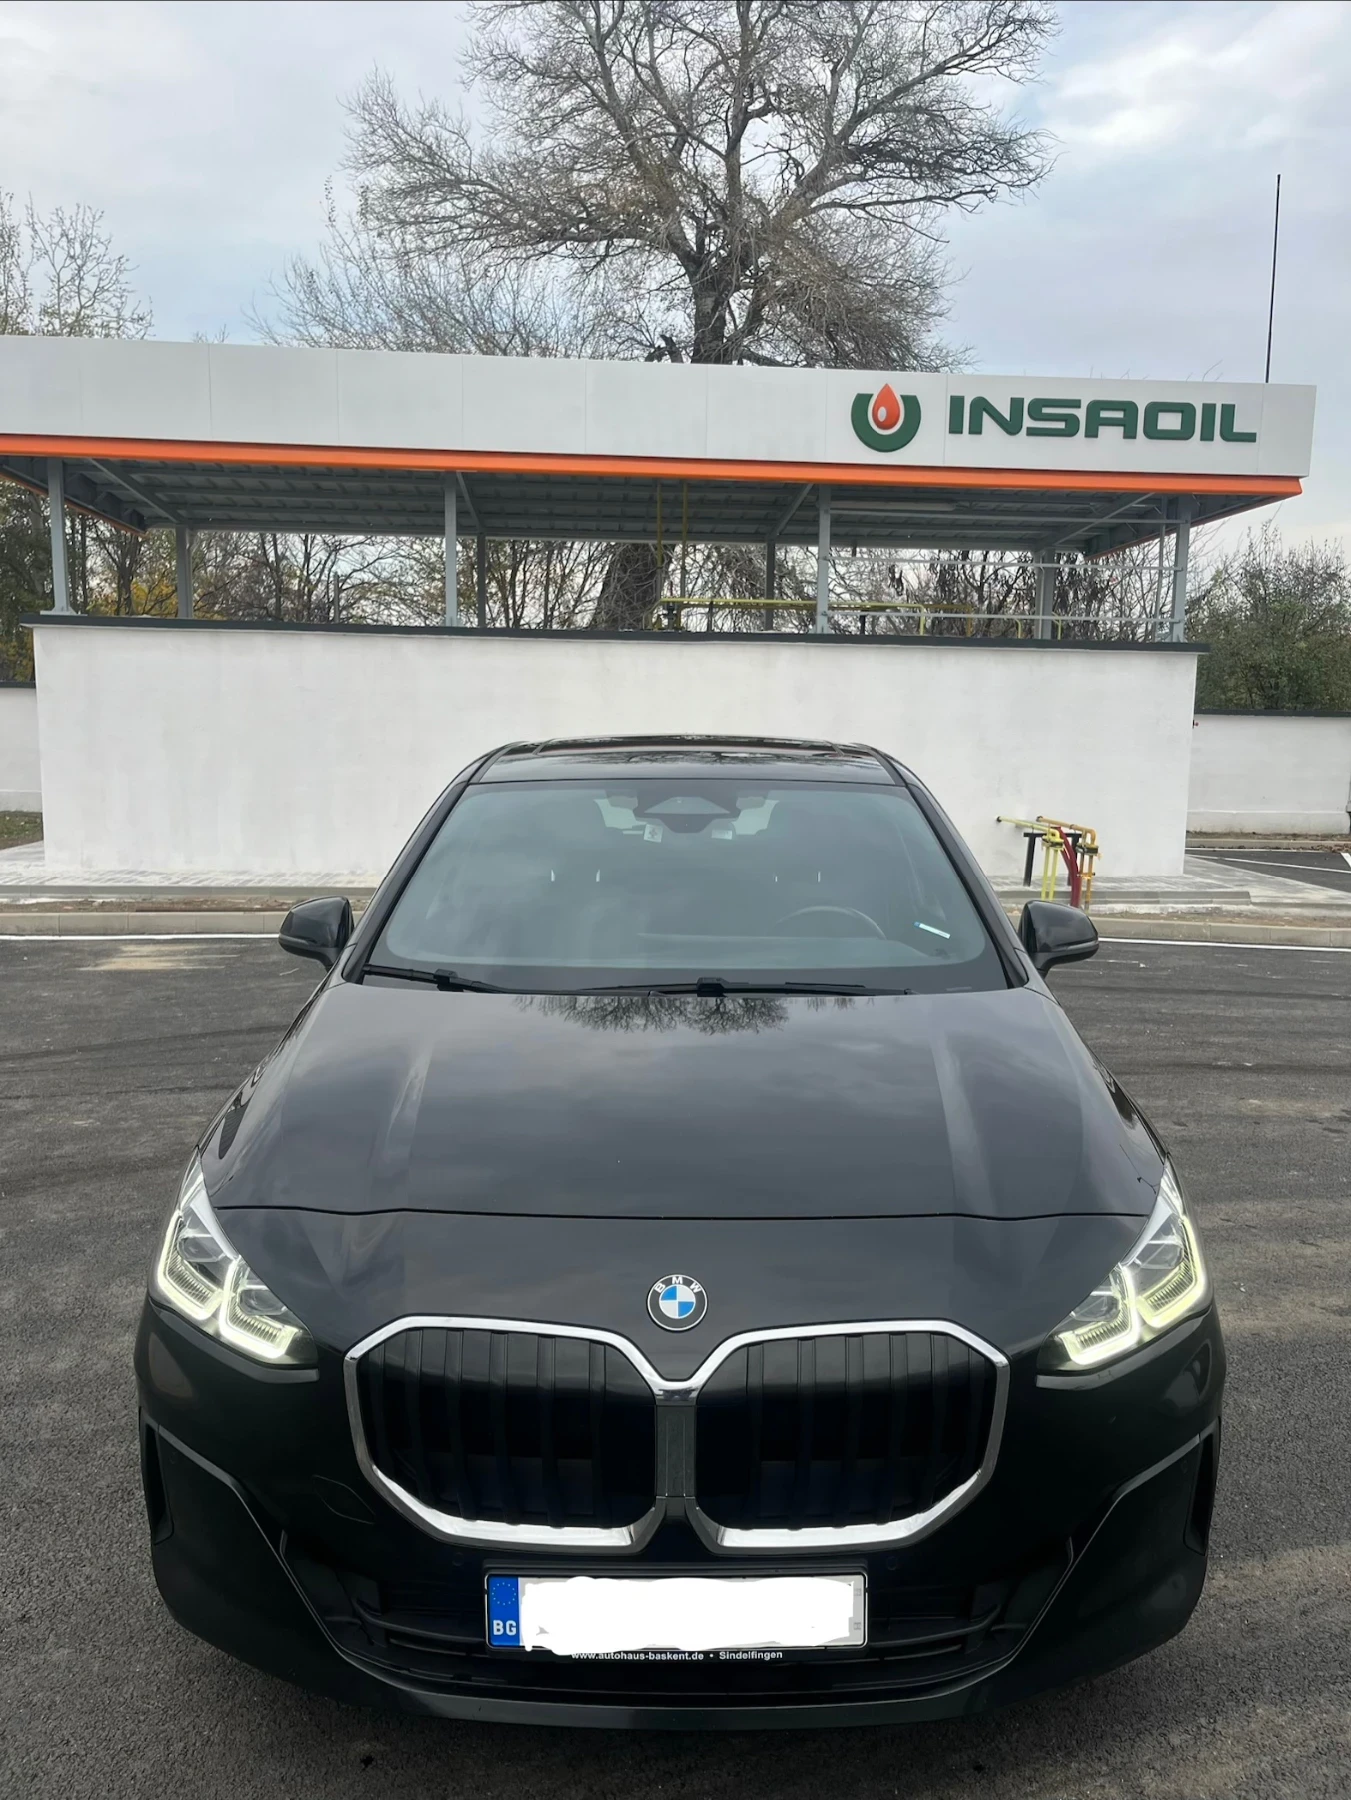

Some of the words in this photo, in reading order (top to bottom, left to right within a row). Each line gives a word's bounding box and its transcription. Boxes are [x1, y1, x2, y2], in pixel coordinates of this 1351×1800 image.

[949, 395, 1257, 443] INSAOIL
[654, 1276, 702, 1293] BMW
[493, 1620, 517, 1636] BG
[571, 1651, 704, 1660] www.autohaus-baskent.de
[719, 1651, 783, 1661] Sindelfingen
